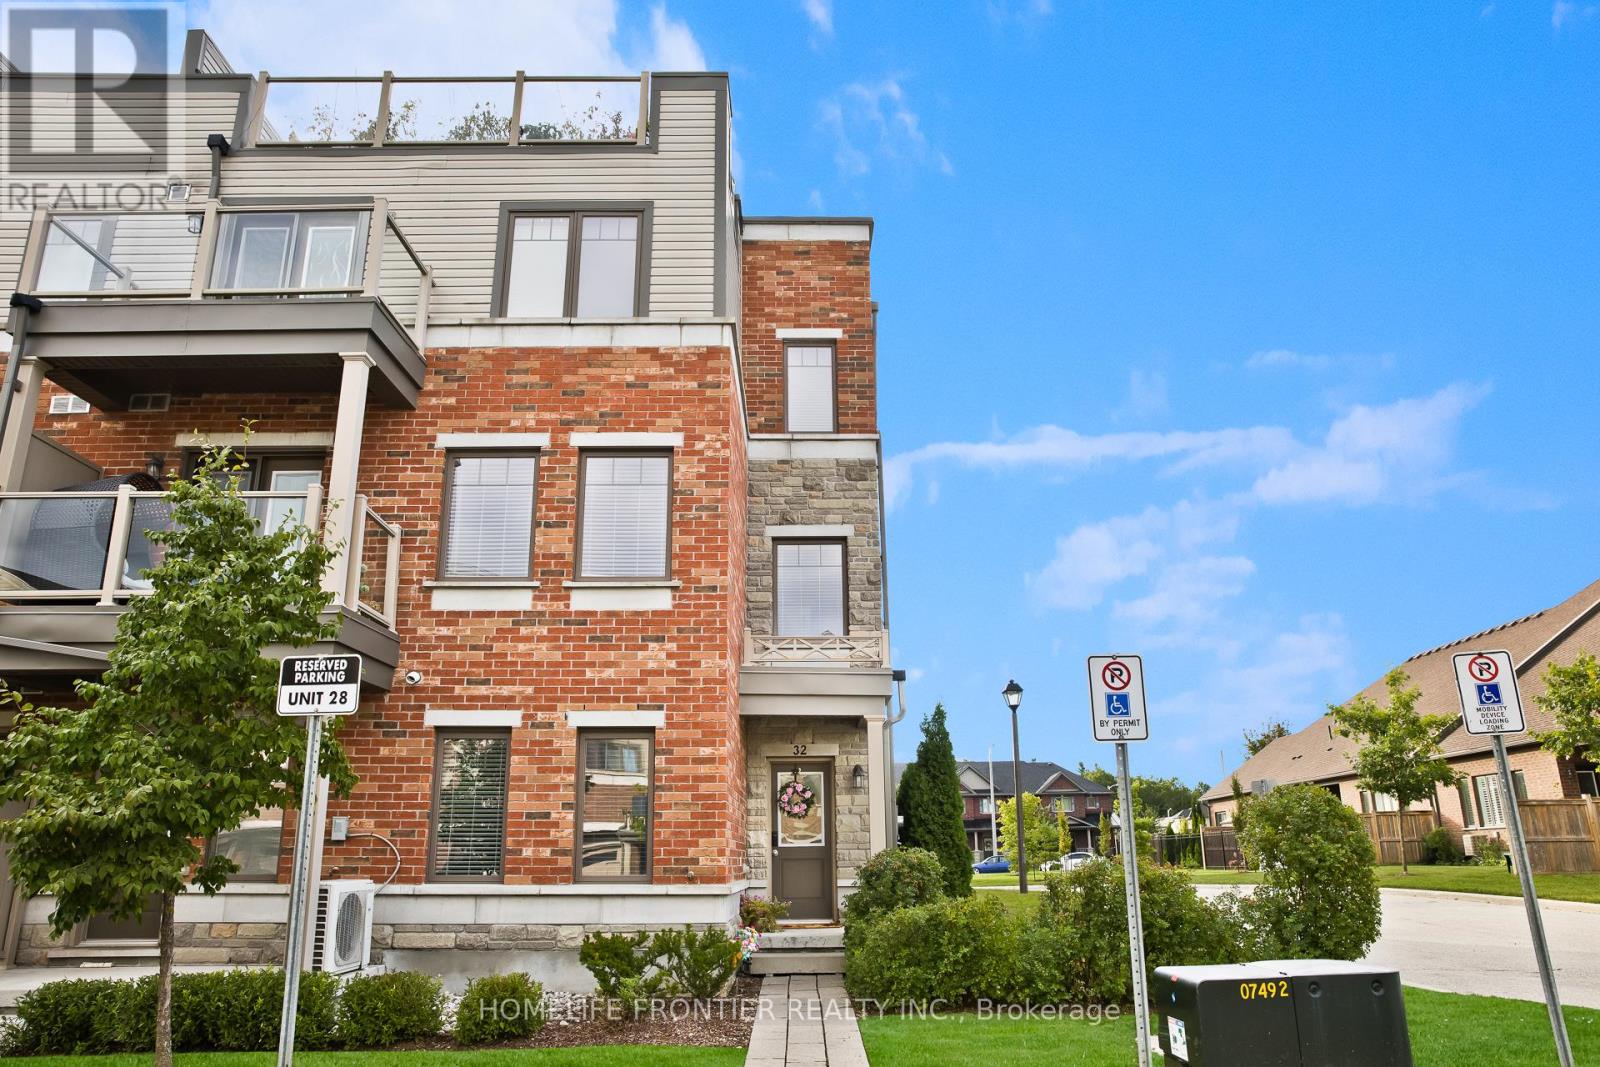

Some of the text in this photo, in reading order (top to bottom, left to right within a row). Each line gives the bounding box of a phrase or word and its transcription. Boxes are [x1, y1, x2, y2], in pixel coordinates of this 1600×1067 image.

[294, 659, 347, 671] RESERVED
[294, 671, 345, 683] PARKING
[288, 691, 348, 705] UNIT 28
[1114, 719, 1140, 727] PERMIT
[793, 745, 807, 755] 32
[1240, 981, 1289, 1000] 07492
